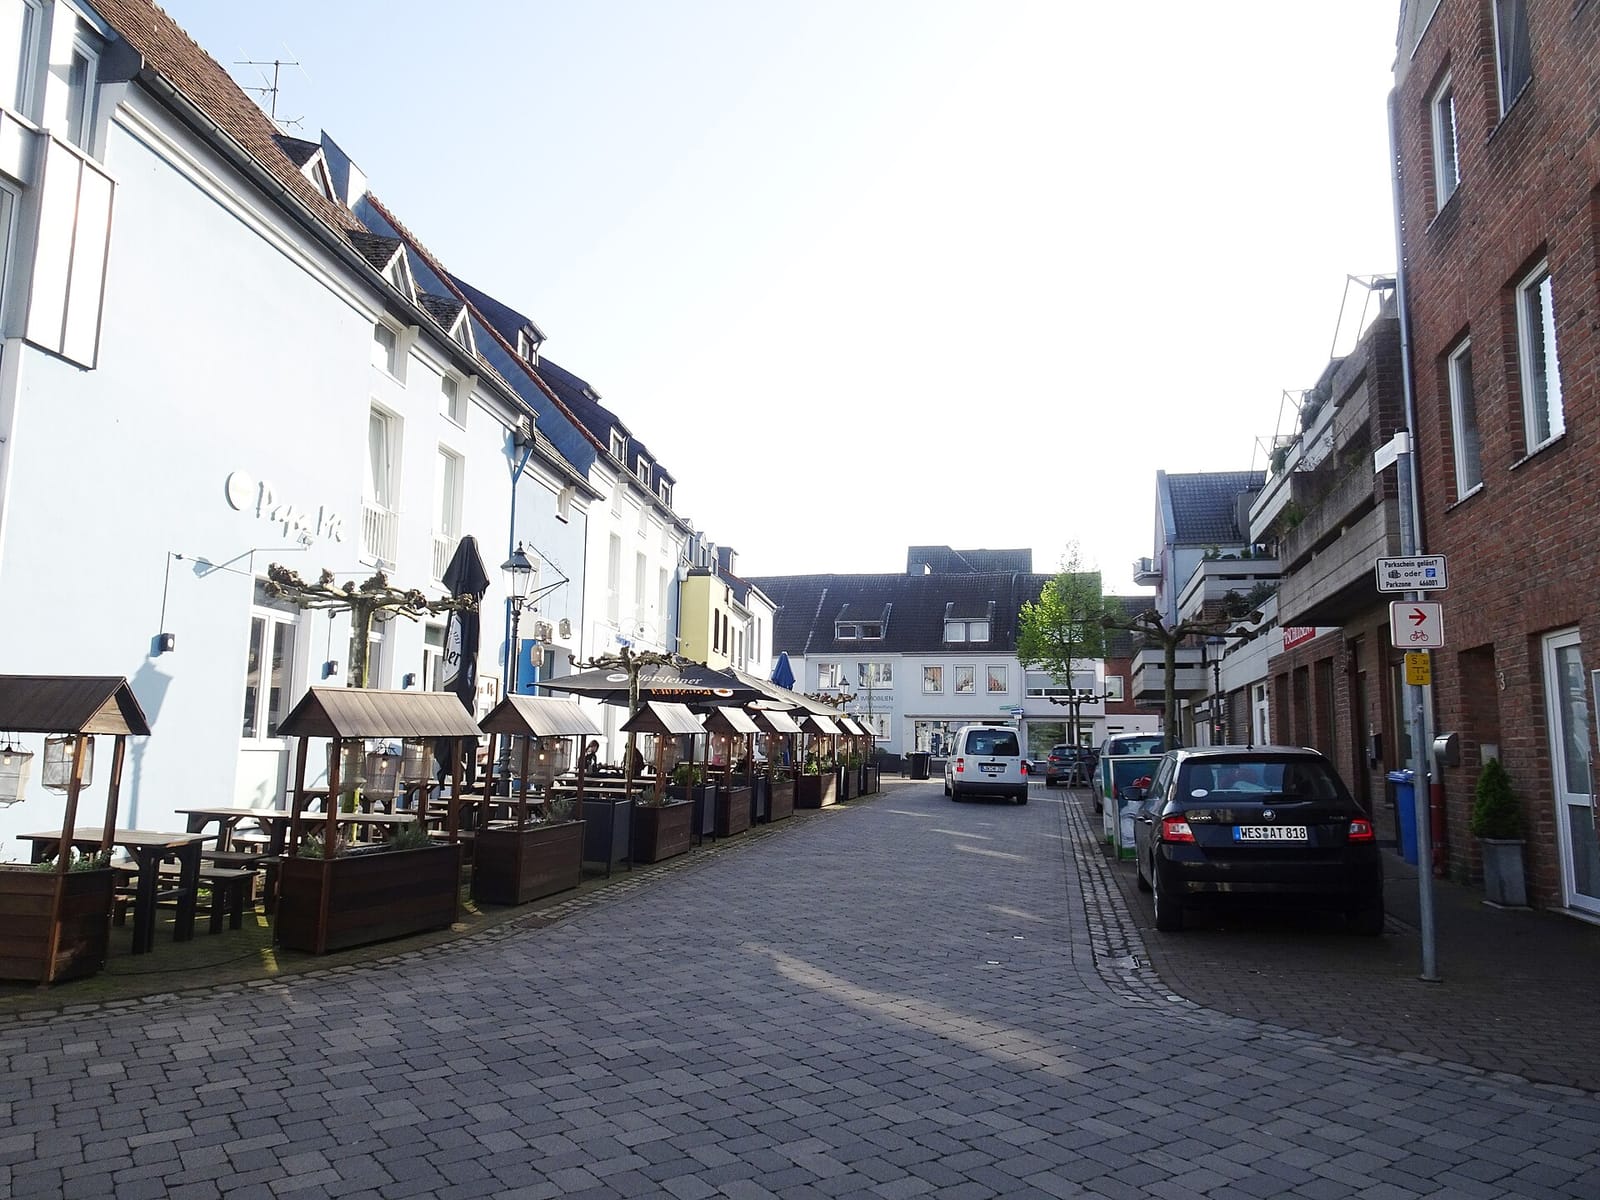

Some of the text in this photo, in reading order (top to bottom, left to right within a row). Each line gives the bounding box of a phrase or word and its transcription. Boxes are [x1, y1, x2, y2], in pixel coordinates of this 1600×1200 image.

[1384, 560, 1415, 568] Parkschein
[1498, 671, 1506, 690] 3
[1241, 827, 1306, 839] WES AT 818
